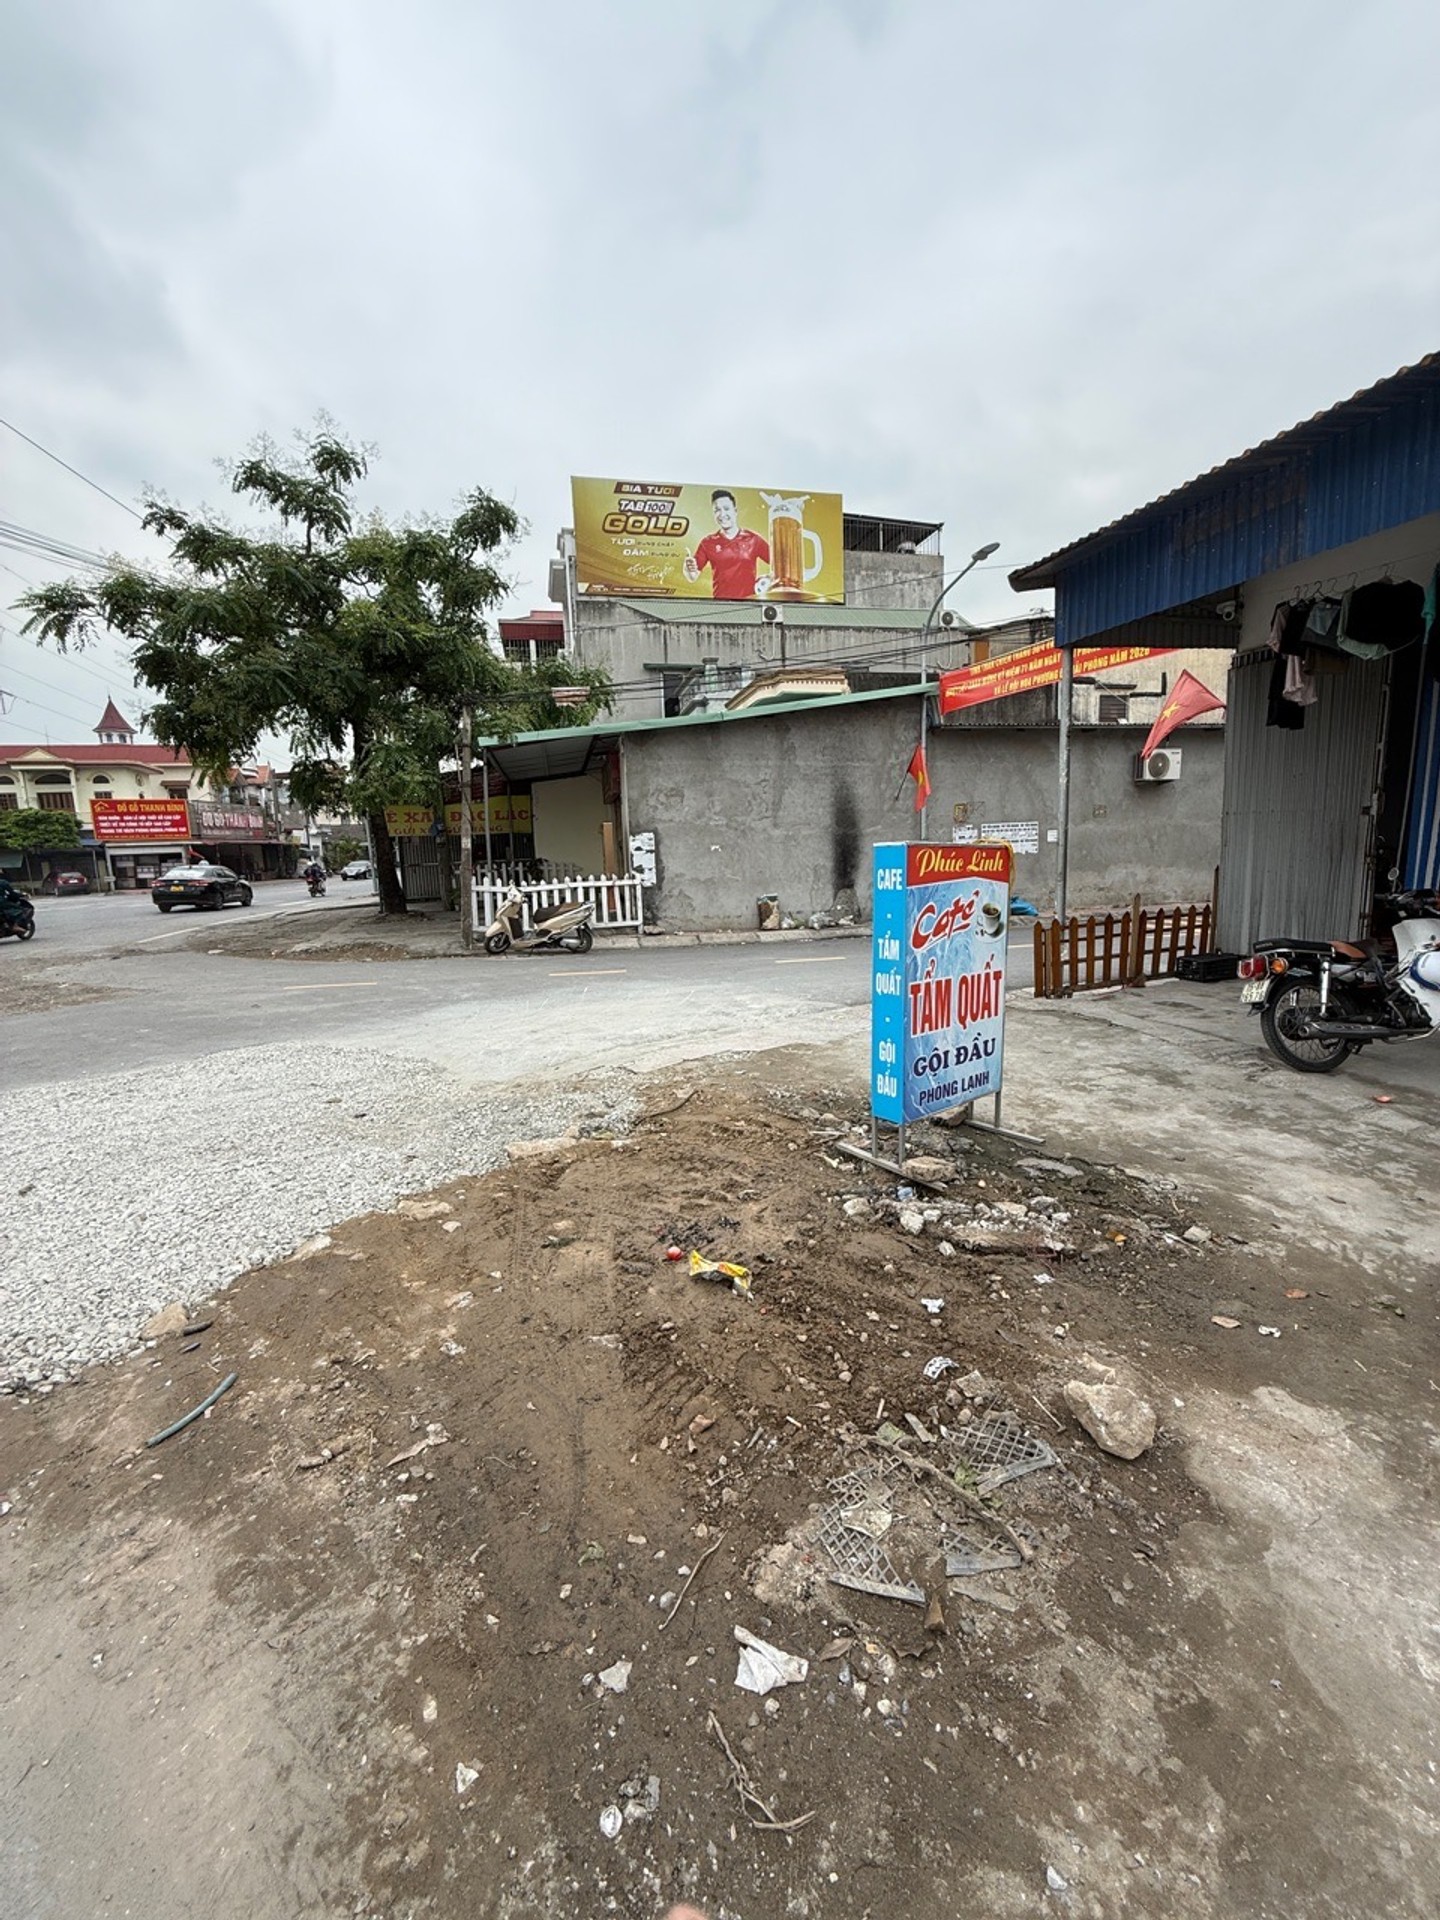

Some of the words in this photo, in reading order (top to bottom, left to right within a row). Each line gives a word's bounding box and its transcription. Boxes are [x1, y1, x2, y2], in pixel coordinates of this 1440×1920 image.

[621, 484, 642, 493] BIA
[603, 514, 689, 537] GOLD
[916, 848, 964, 877] Phúc
[966, 849, 1004, 872] Linh
[877, 867, 903, 891] CAFE
[876, 966, 902, 997] QUẤT
[910, 958, 952, 1036] TẨM
[957, 953, 1003, 1031] QUẤT
[879, 1037, 897, 1068] GỘI
[913, 1046, 951, 1077] GỘI
[954, 1032, 996, 1066] ĐẦU
[919, 1079, 959, 1107] PHÒNG
[961, 1070, 990, 1094] LẠNH
